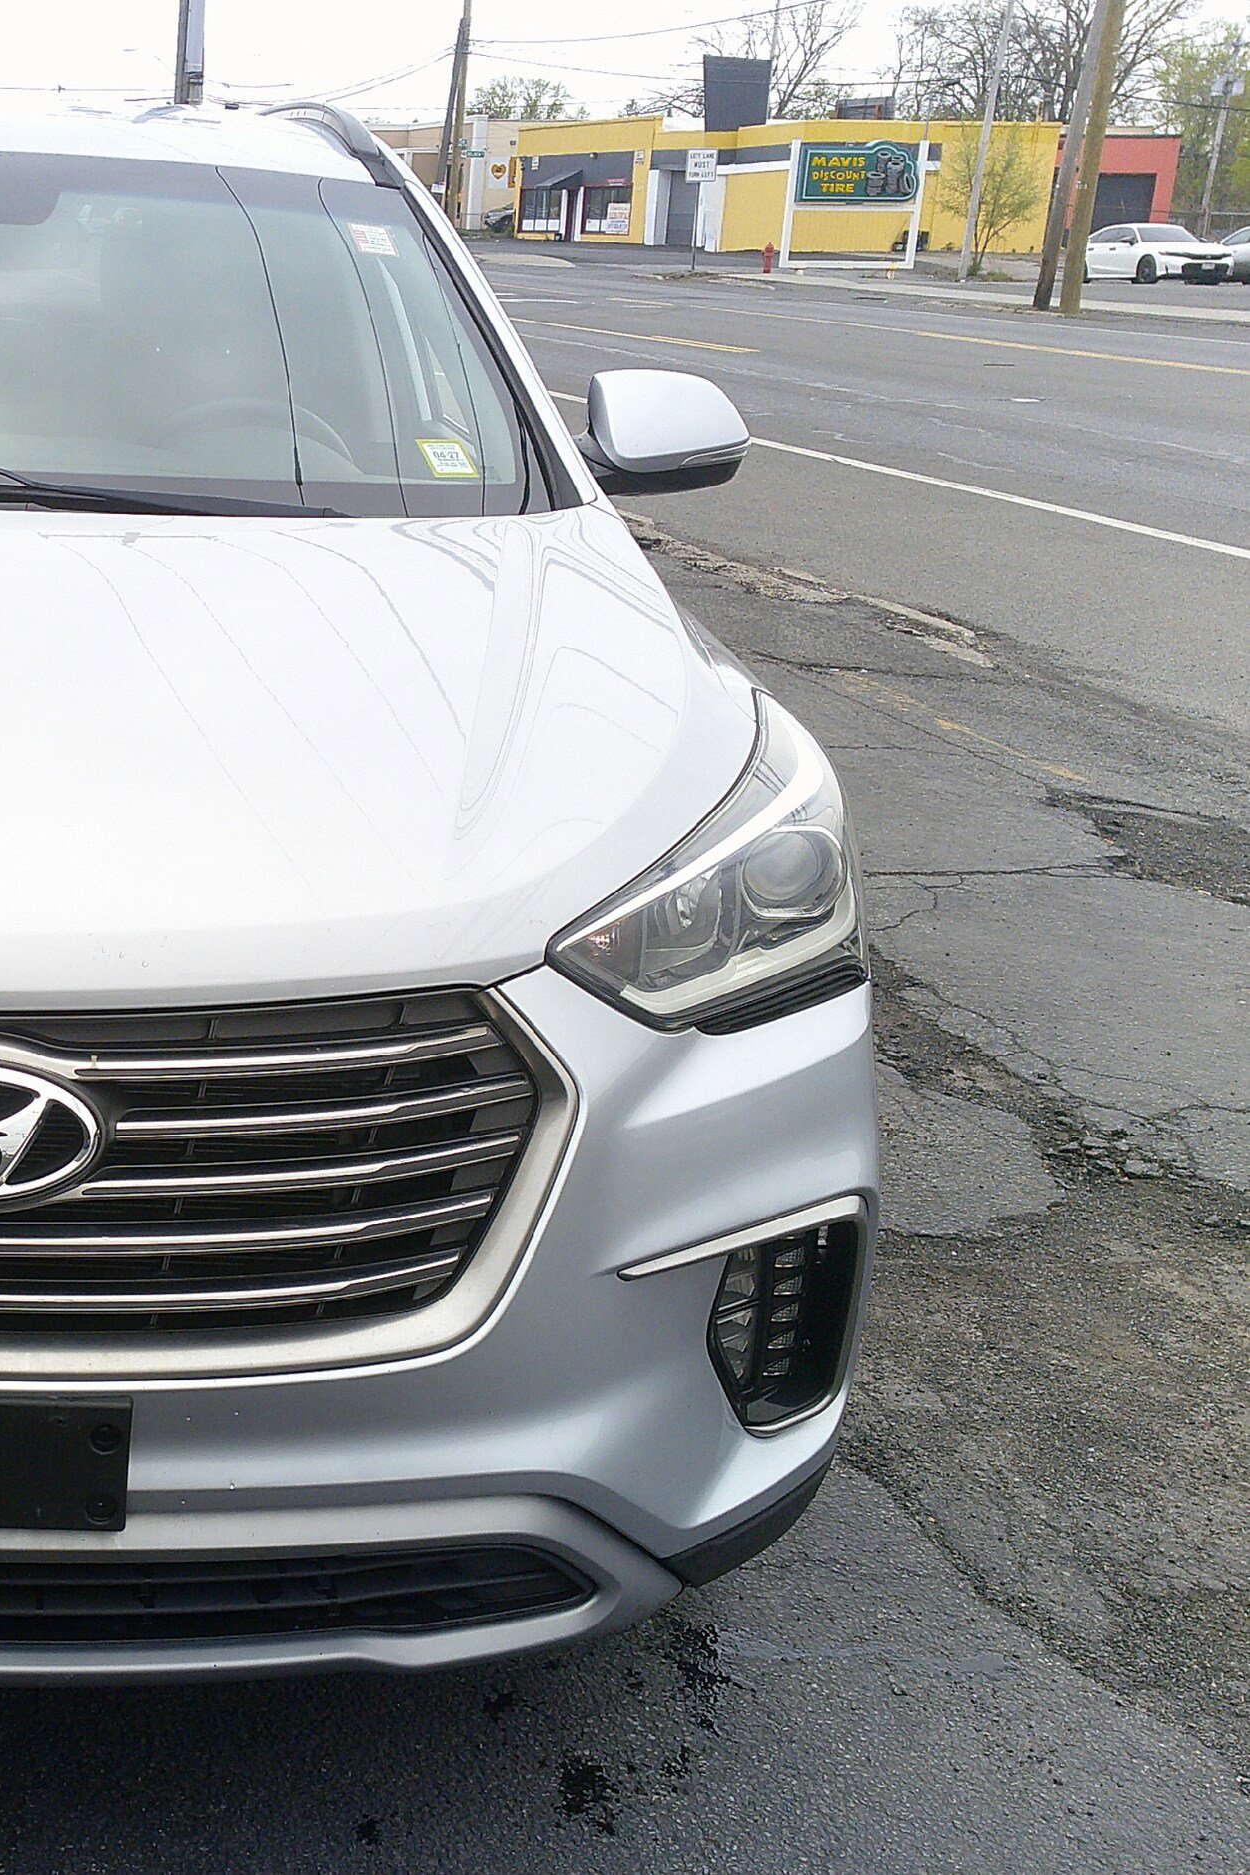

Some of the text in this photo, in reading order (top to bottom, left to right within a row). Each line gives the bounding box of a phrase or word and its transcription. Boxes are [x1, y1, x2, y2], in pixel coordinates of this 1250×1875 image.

[811, 156, 866, 168] MAVIS
[812, 170, 867, 181] DISCOUNT
[820, 183, 855, 193] TIRE
